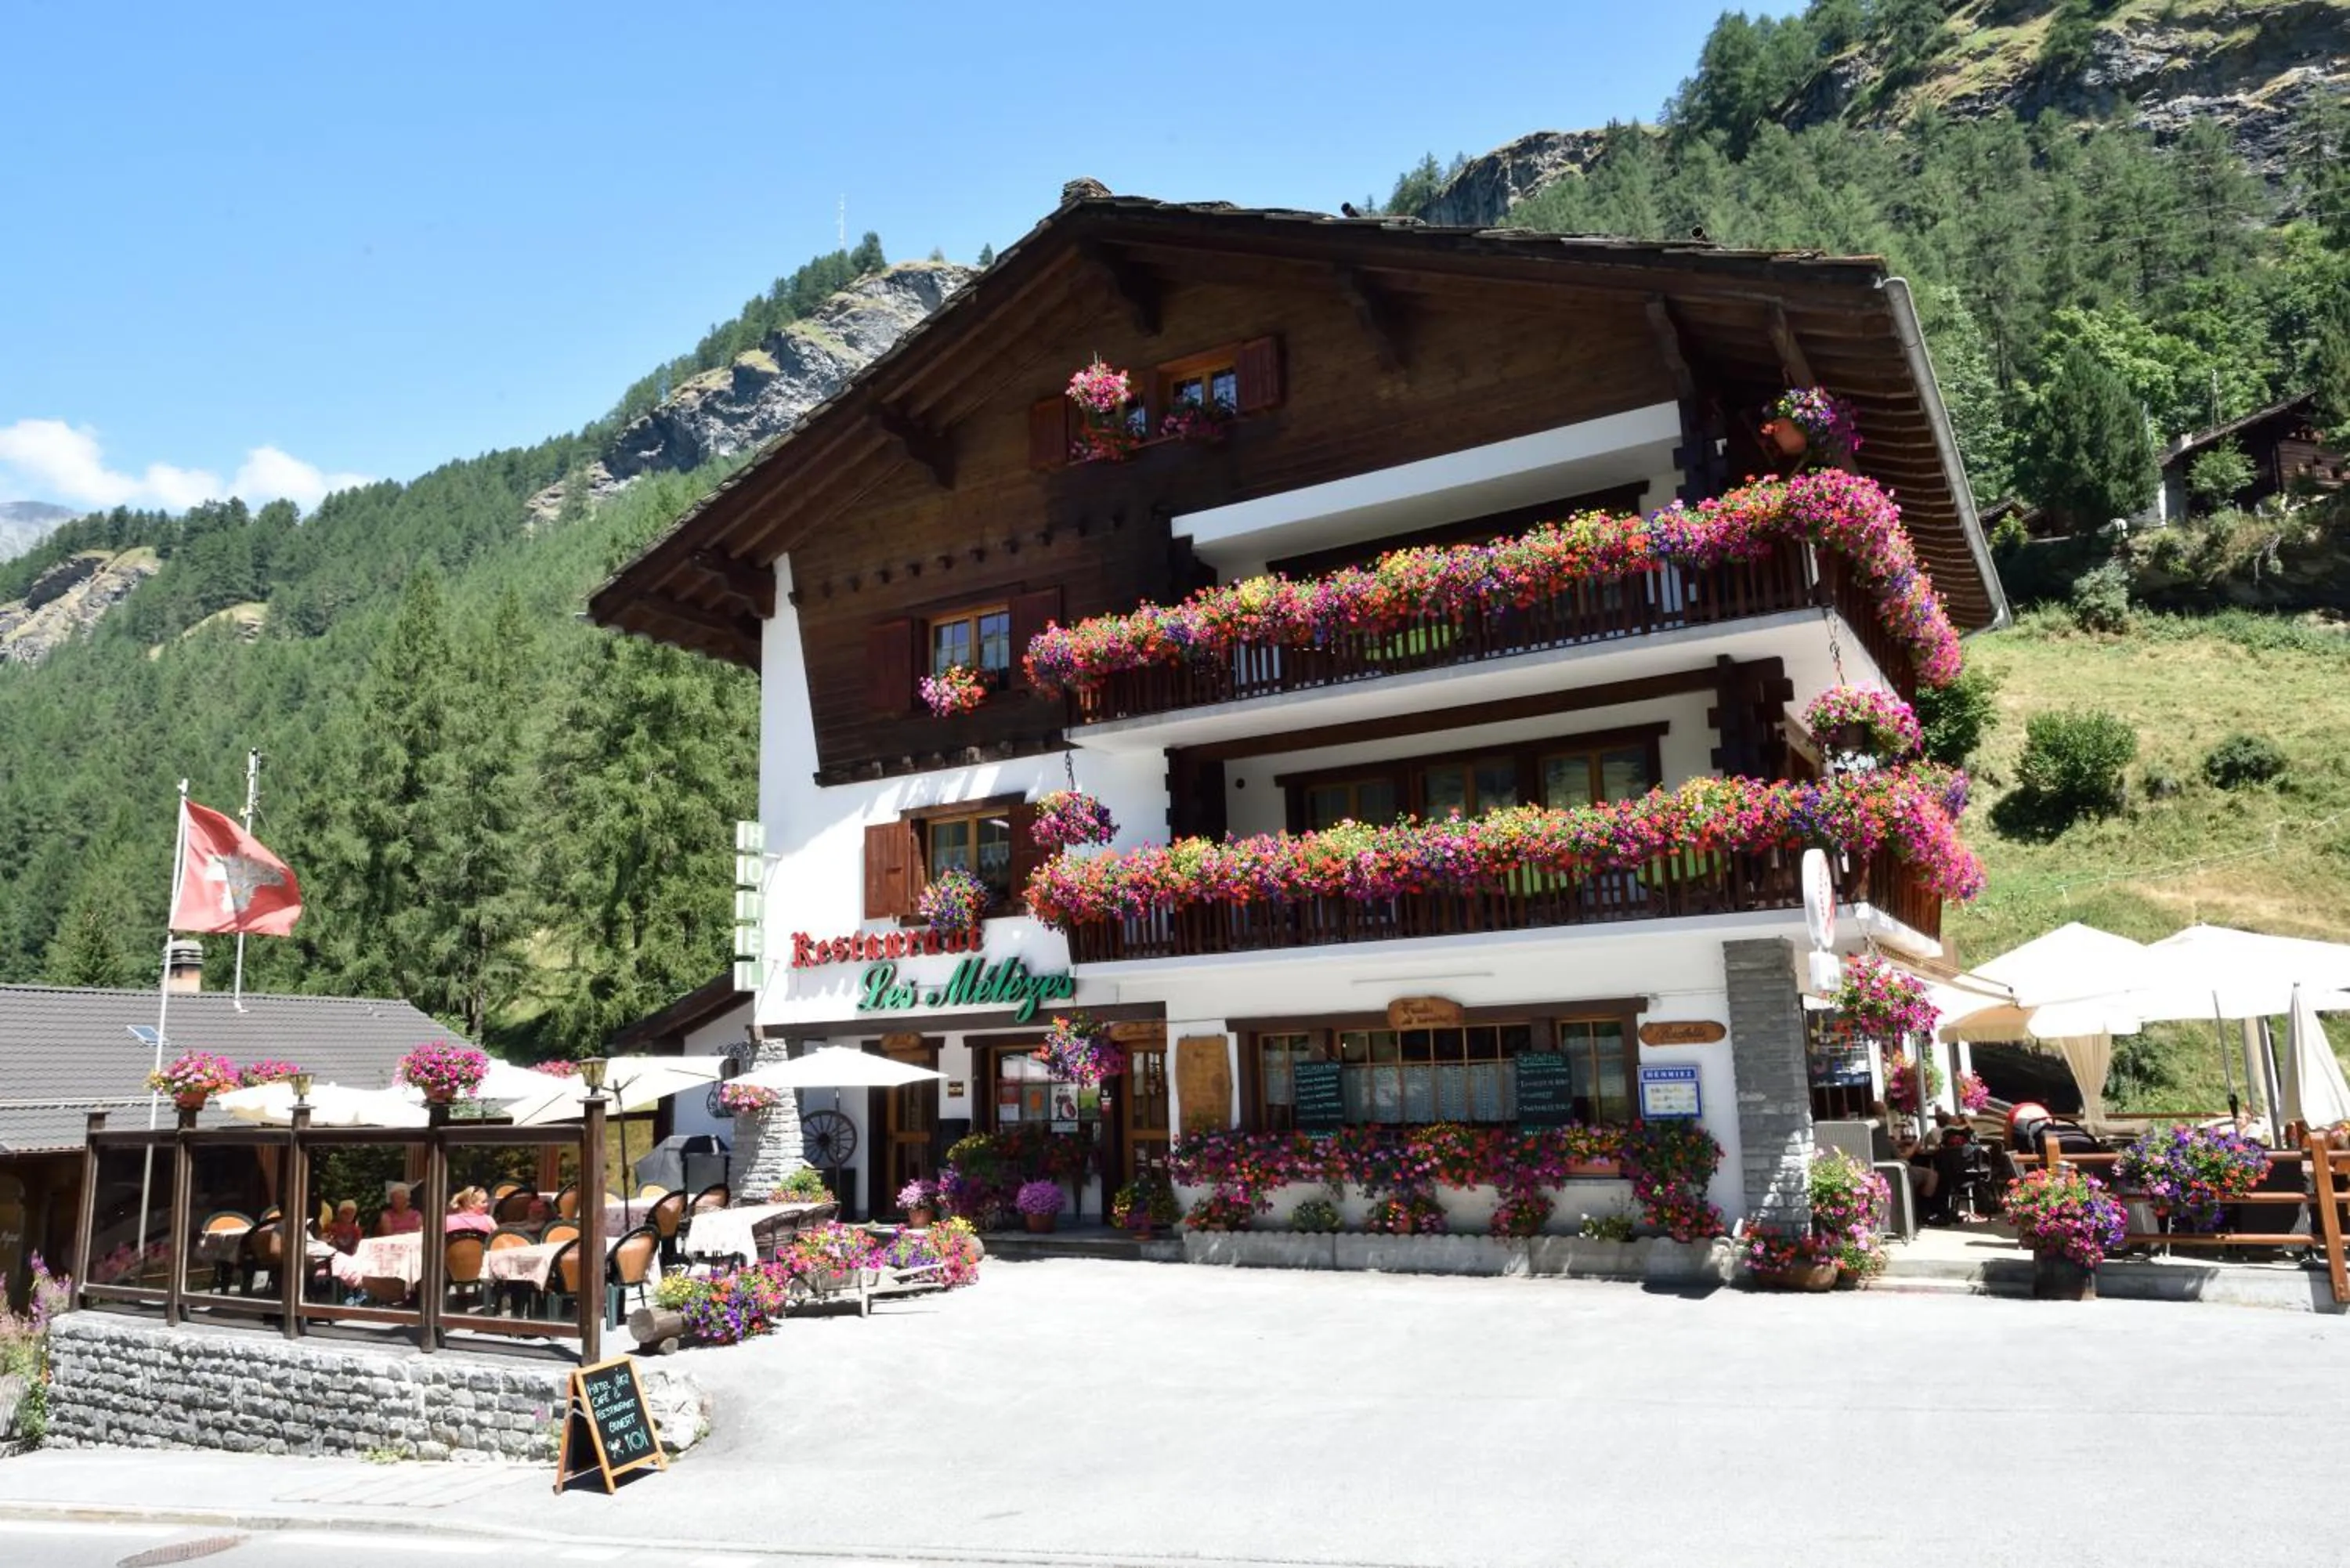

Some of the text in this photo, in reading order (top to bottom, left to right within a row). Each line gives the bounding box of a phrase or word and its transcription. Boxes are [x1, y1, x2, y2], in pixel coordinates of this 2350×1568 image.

[745, 824, 765, 991] HOTEL
[791, 926, 985, 969] Restaurant
[857, 956, 1075, 1023] Les Mélèzes
